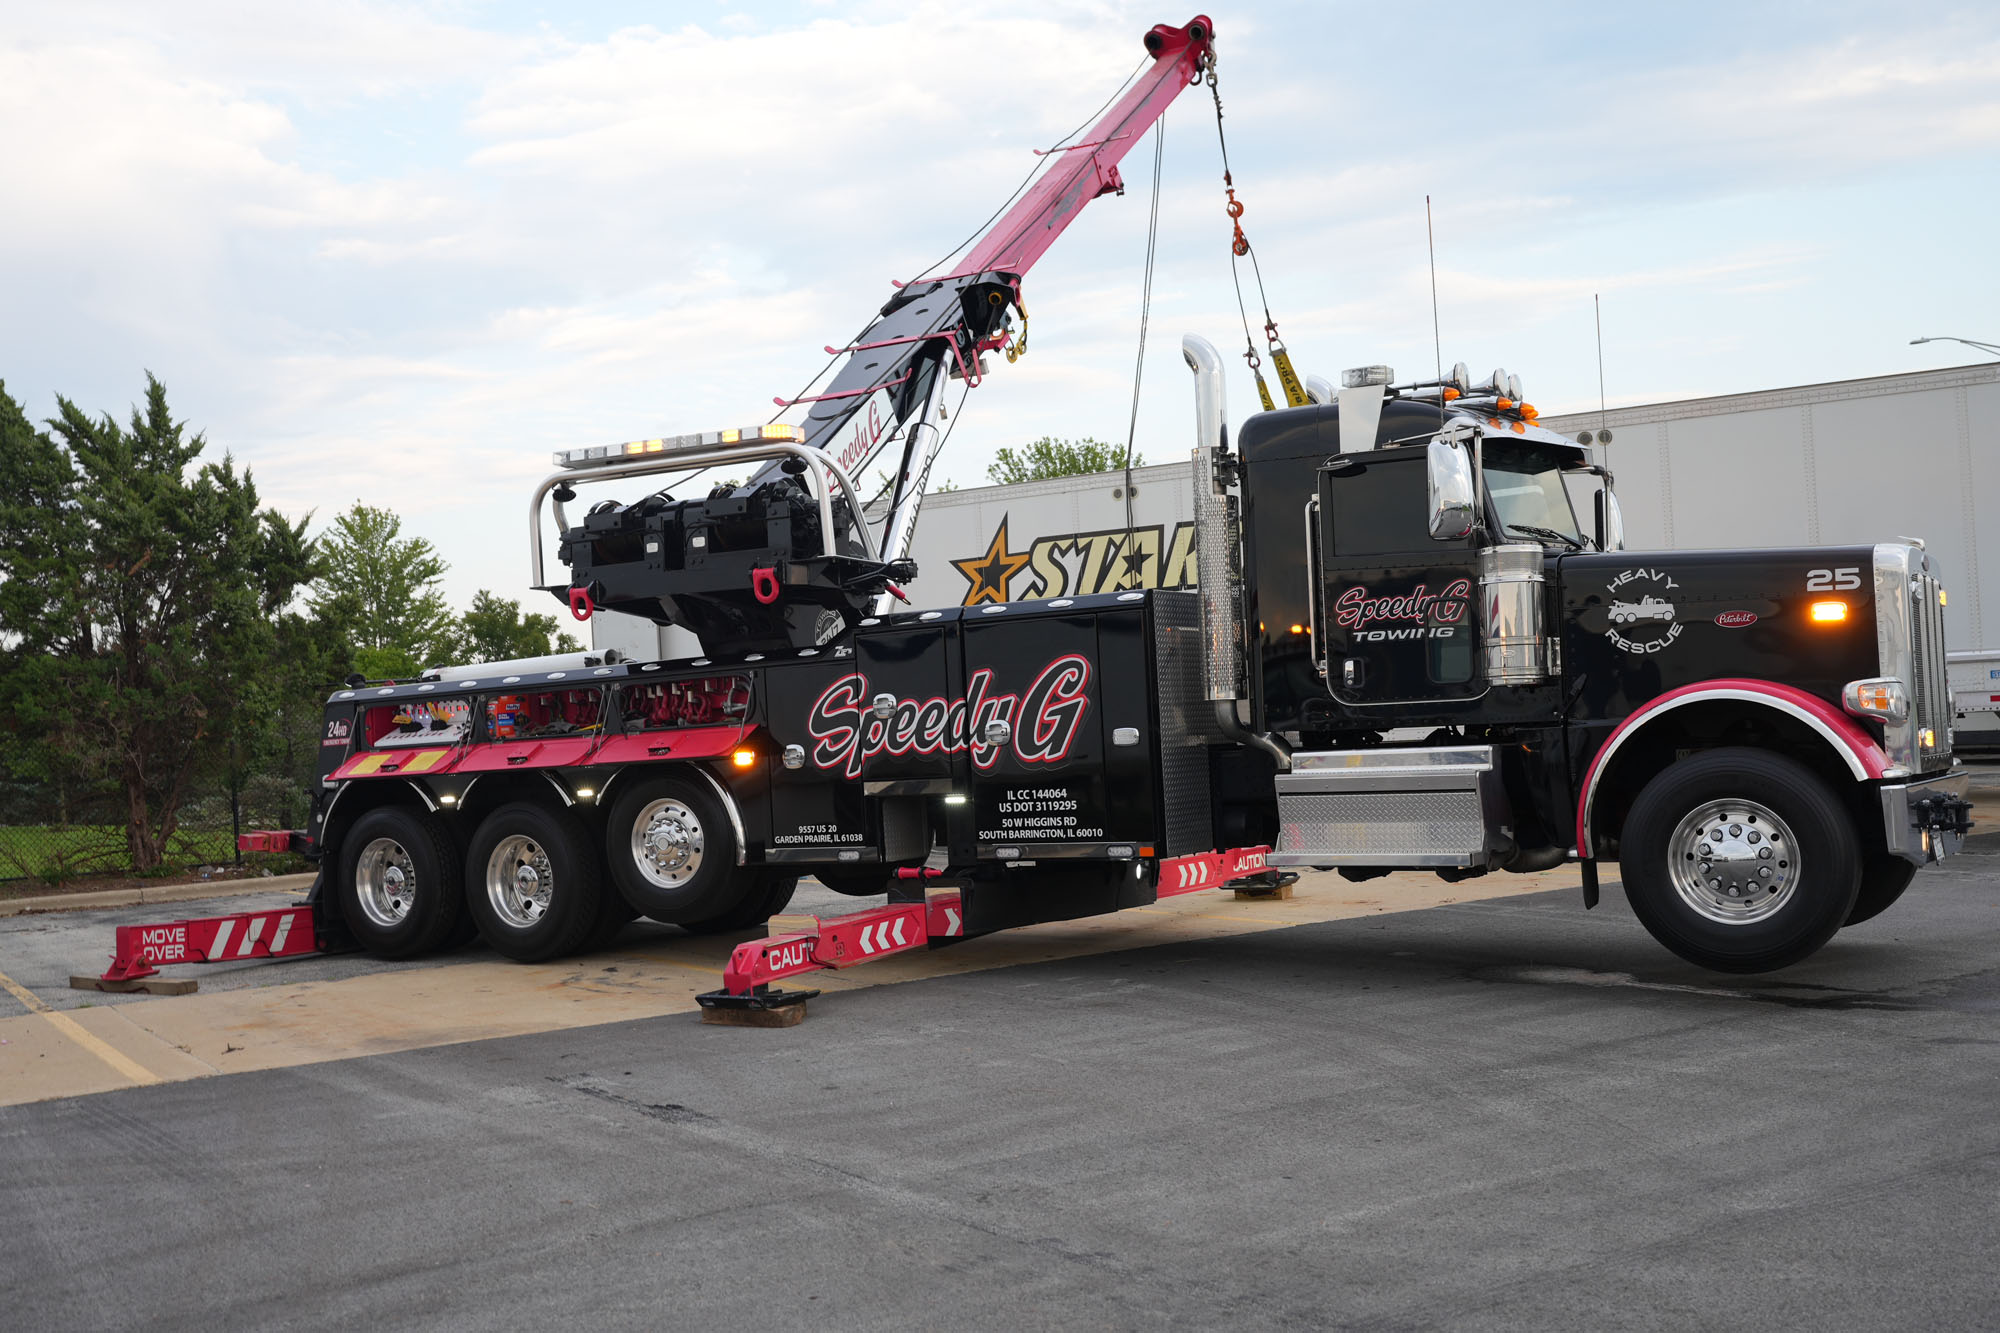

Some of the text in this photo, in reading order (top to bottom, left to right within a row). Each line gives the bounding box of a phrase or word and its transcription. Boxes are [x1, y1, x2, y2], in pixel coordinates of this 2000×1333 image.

[1606, 568, 1680, 593] HEAVY
[1806, 567, 1862, 592] 25
[1719, 612, 1754, 624] Peterbilt
[1353, 626, 1455, 642] TOWING
[1604, 621, 1684, 654] RESCUE
[808, 653, 1090, 779] Speedy G
[1007, 788, 1067, 800] IL CC 144064
[999, 800, 1077, 813] US DOT 3119295
[798, 824, 837, 834] 9557 US 20
[1002, 816, 1077, 828] 50 W HIGGINS RD
[775, 833, 863, 844] GARDEN PRAIRIE, IL 61038
[978, 828, 1103, 840] SOUTH BARRINGTON, IL 60010
[142, 927, 186, 945] MOVE
[143, 944, 186, 961] OVER
